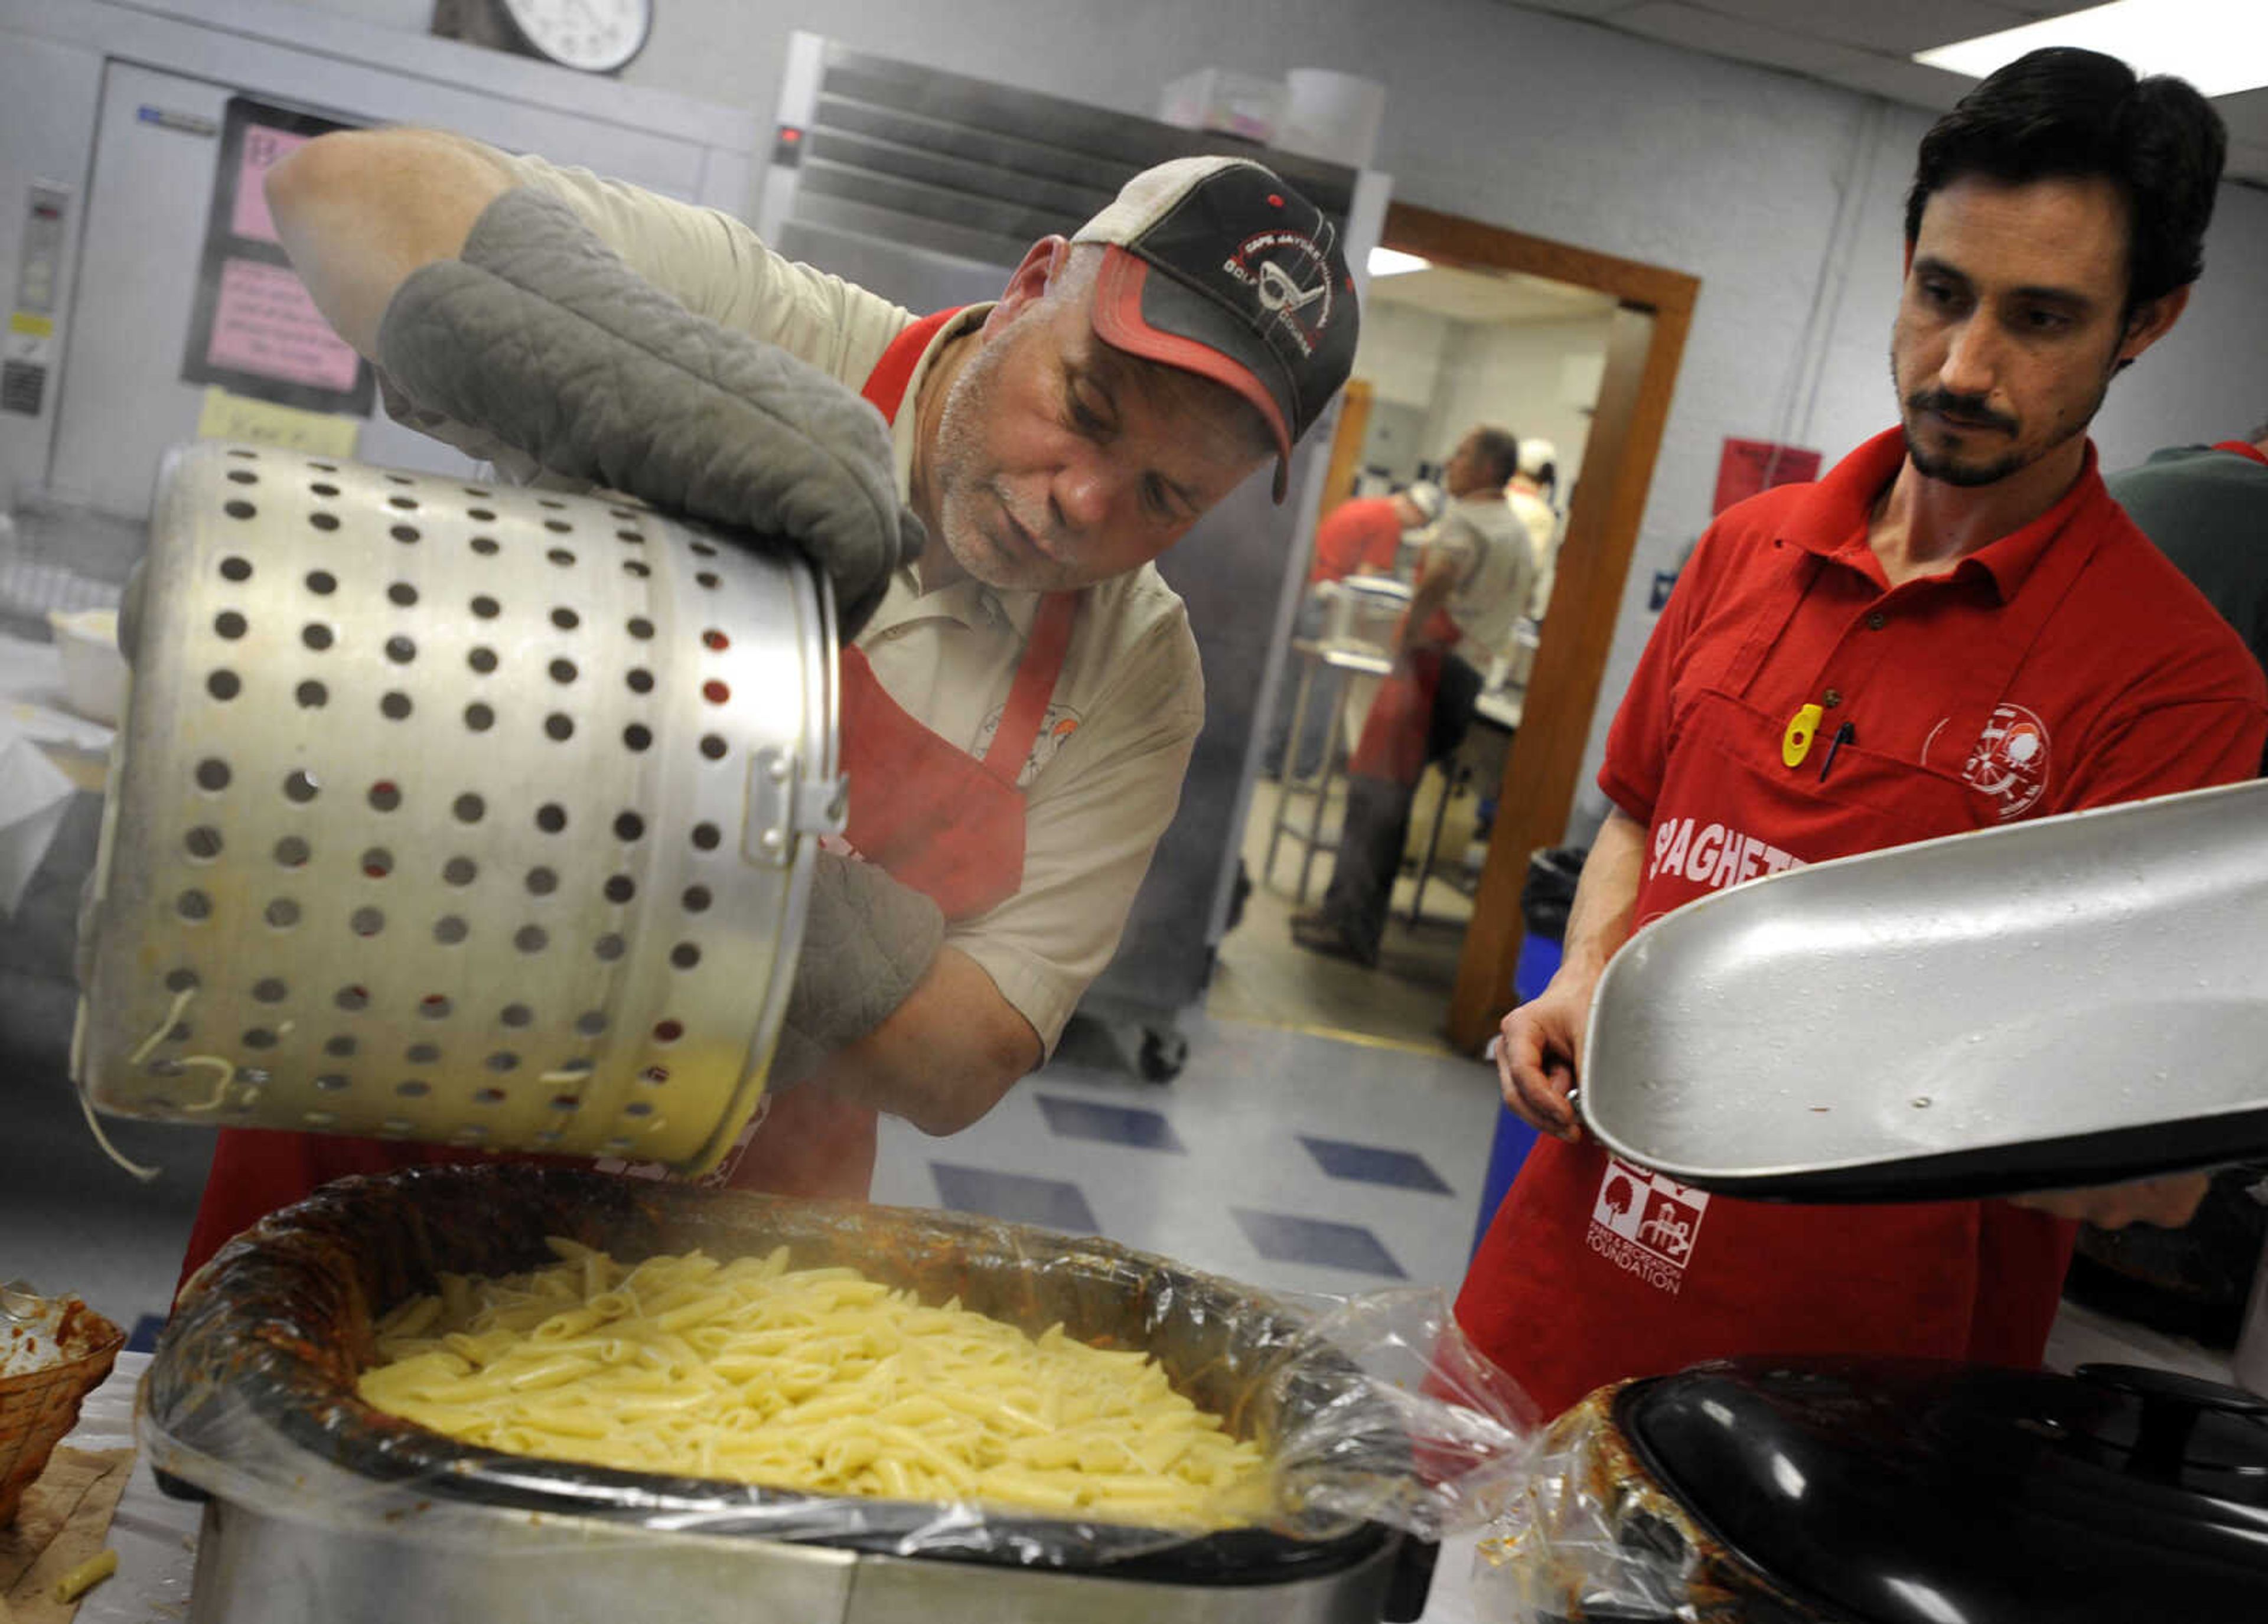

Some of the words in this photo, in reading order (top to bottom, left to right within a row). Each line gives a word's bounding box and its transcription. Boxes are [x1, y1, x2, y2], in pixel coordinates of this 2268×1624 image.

[1223, 259, 1259, 285] GOLF
[1585, 1230, 1681, 1294] FOUNDATION
[1622, 1240, 1682, 1280] RECREATION
